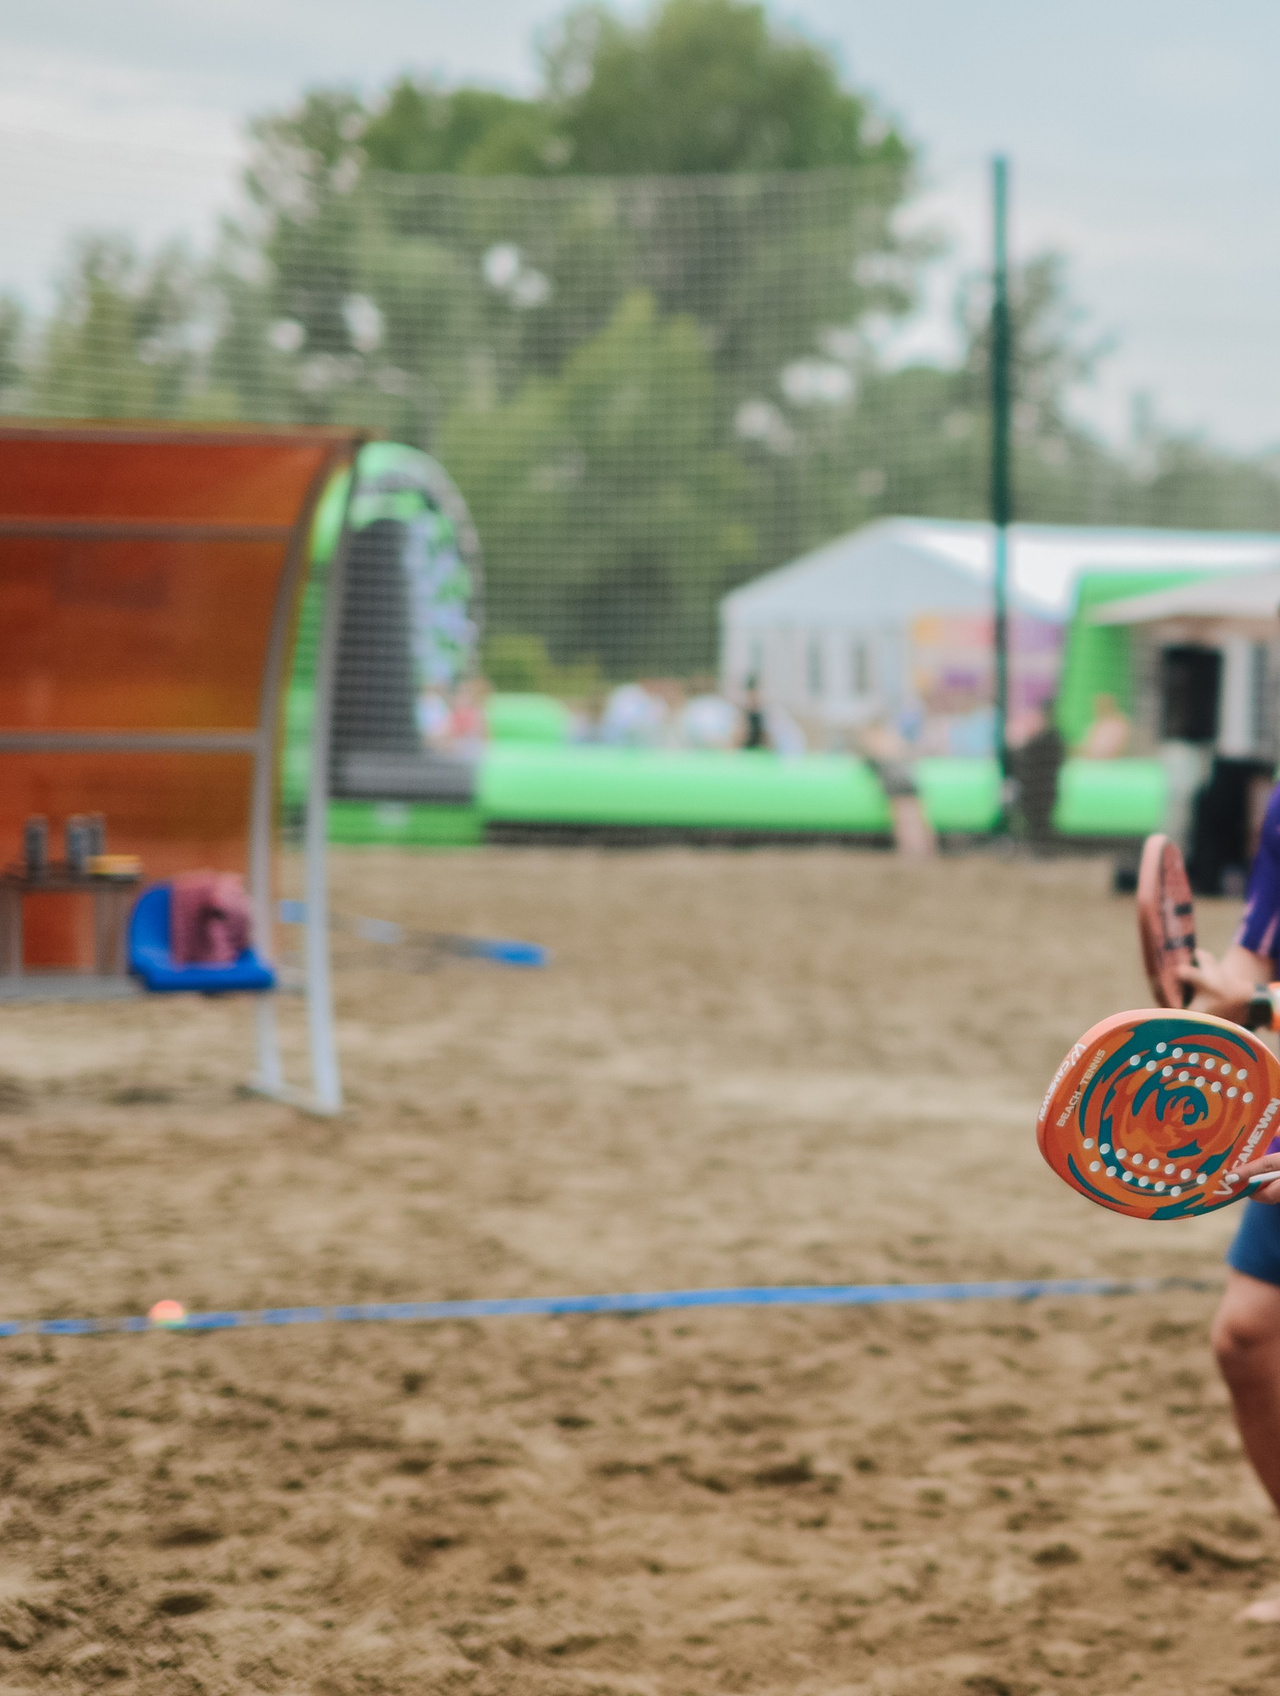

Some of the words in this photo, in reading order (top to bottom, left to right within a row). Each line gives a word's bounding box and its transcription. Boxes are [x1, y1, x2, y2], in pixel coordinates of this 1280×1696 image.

[1038, 1060, 1070, 1122] CAMEWIN
[1056, 1091, 1082, 1127] BEACH
[1079, 1049, 1106, 1085] TENNIS
